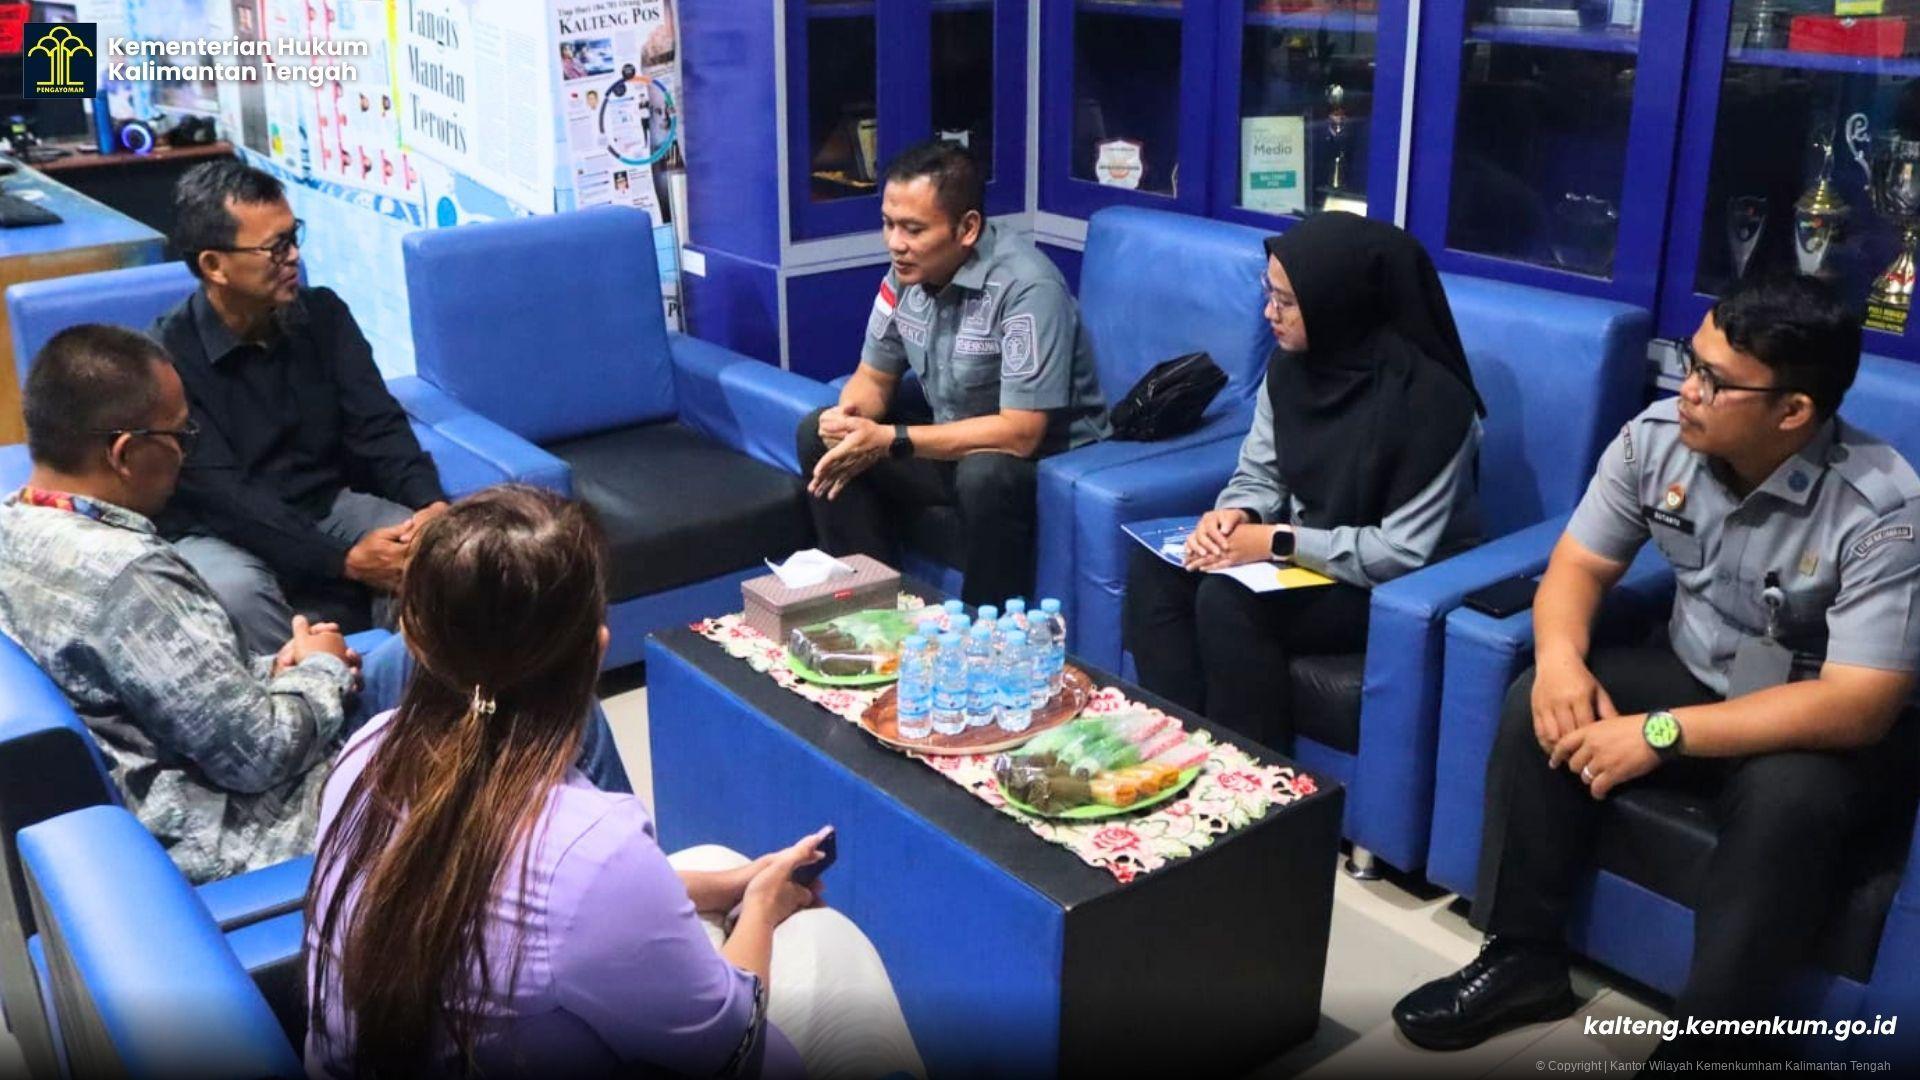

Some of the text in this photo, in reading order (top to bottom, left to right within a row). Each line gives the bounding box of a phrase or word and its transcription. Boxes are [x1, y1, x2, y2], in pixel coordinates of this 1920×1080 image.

[405, 0, 459, 54] Tangis
[559, 7, 660, 35] KALTENG POS
[408, 44, 466, 104] Mantan
[409, 92, 468, 154] Teroris
[1254, 143, 1292, 155] Media
